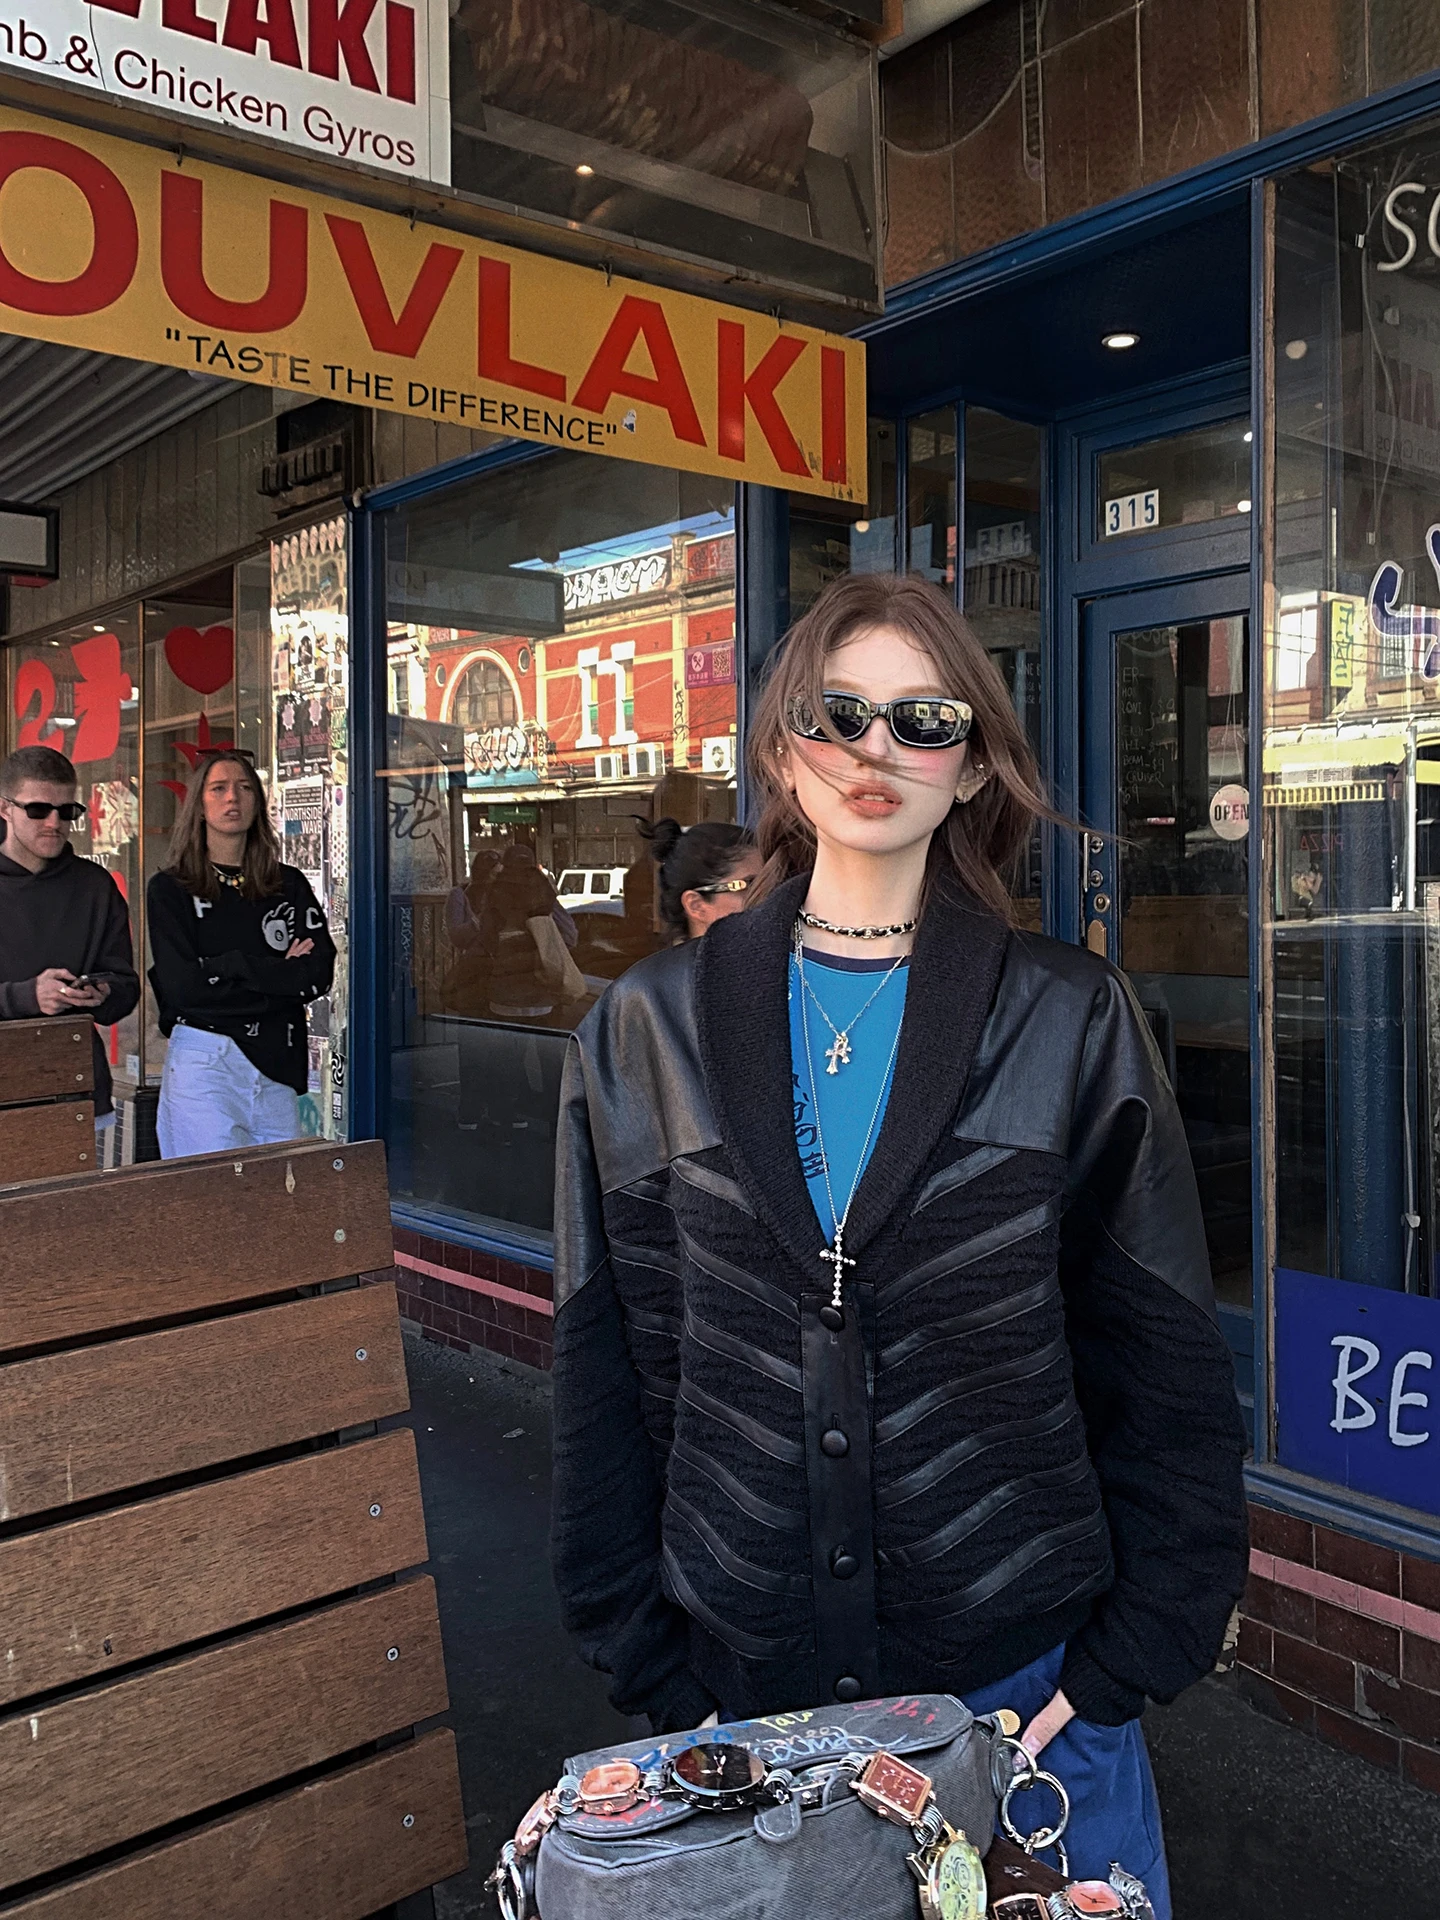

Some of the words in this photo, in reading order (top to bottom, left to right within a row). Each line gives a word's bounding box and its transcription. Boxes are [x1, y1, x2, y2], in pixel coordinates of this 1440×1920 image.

[65, 35, 98, 78] &
[114, 50, 288, 132] Chicken
[303, 105, 416, 167] Gyros
[83, 0, 416, 104] LAKI
[0, 130, 847, 485] OUVLAKI
[165, 327, 312, 385] "TASTE
[323, 364, 394, 402] THE
[408, 381, 617, 447] DIFFERENCE"
[1109, 493, 1155, 532] 315
[284, 805, 322, 822] NORTHSIDE
[301, 819, 322, 835] WAVE
[1213, 803, 1250, 822] OPEN
[1330, 1335, 1433, 1447] BE
